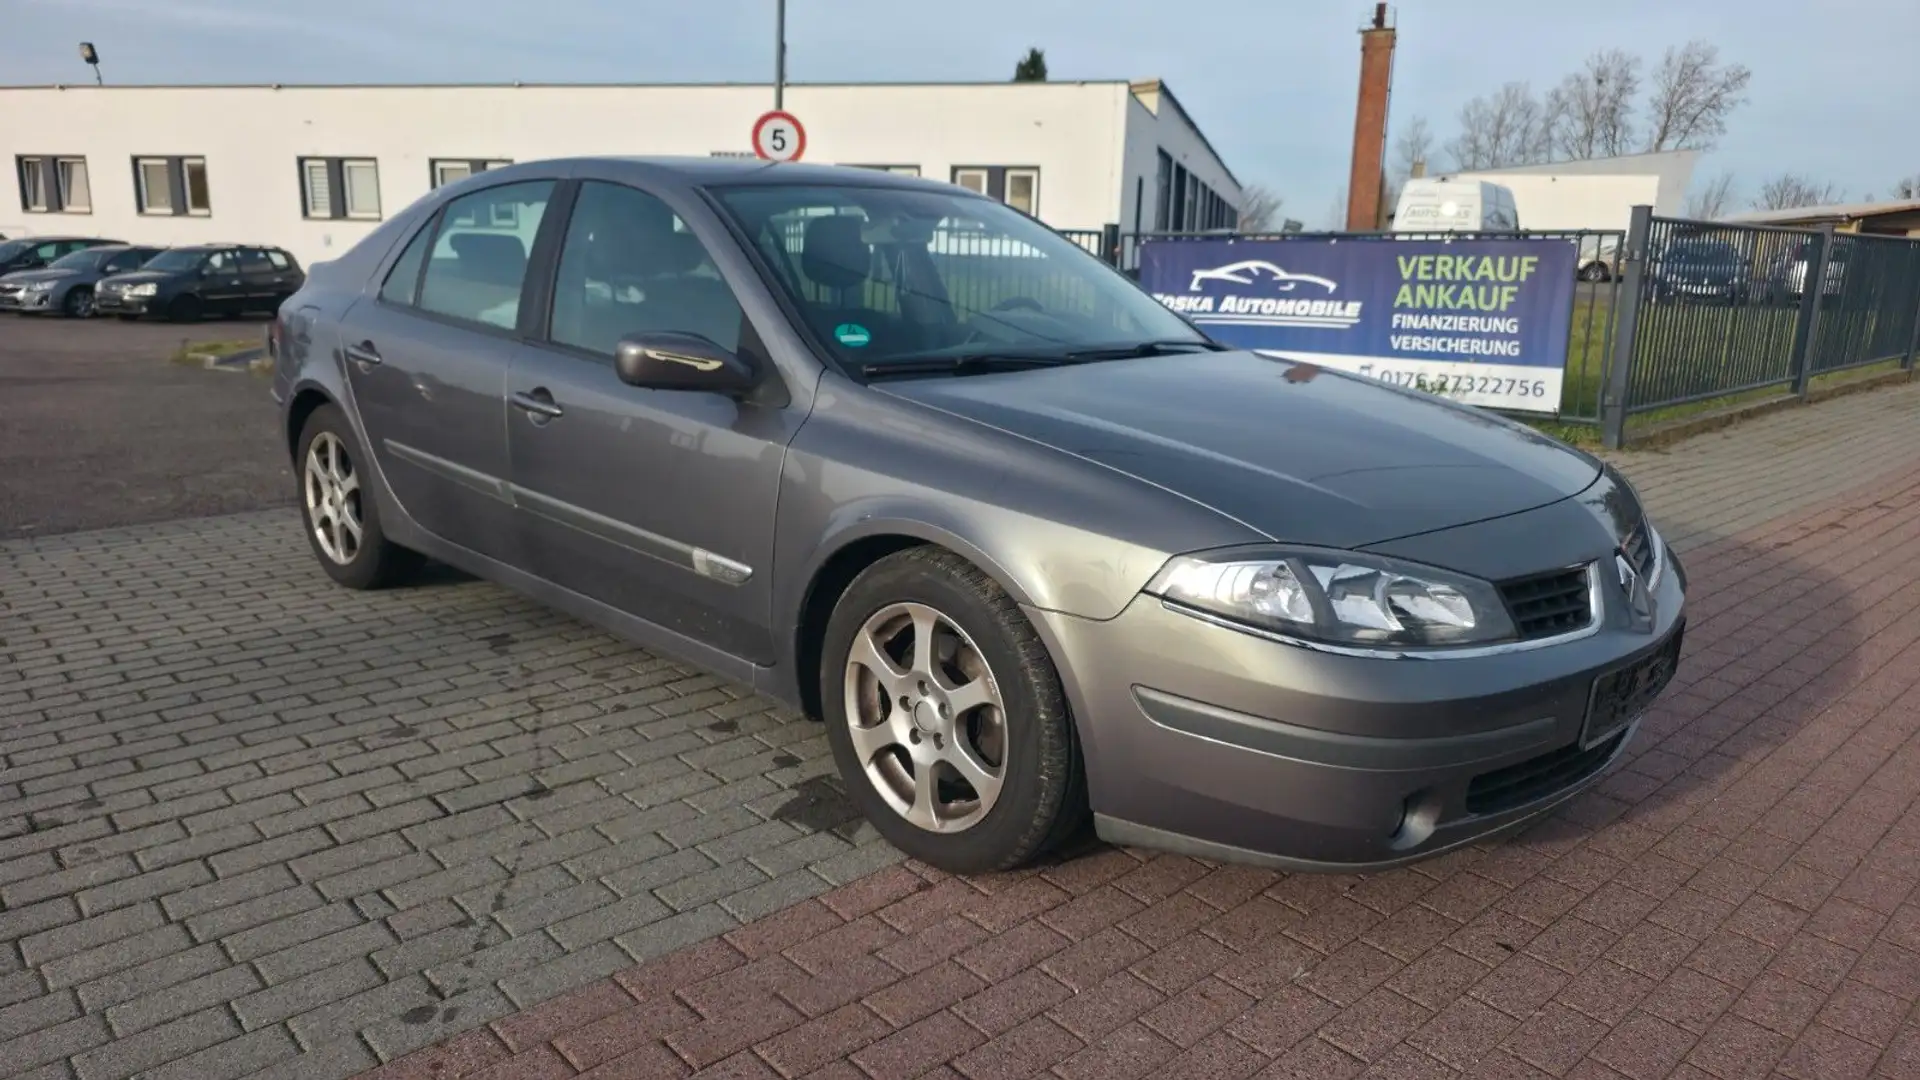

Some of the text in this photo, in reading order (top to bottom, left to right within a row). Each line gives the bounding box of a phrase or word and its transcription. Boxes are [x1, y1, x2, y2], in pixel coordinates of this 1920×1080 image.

[772, 128, 786, 152] 5
[1397, 255, 1539, 282] VERKAUF
[1218, 294, 1362, 317] AUTOMOBILE
[1393, 283, 1519, 312] ANKAUF
[1392, 313, 1519, 334] FINANZIERUNG
[1390, 334, 1521, 357] VERSICHERUNG
